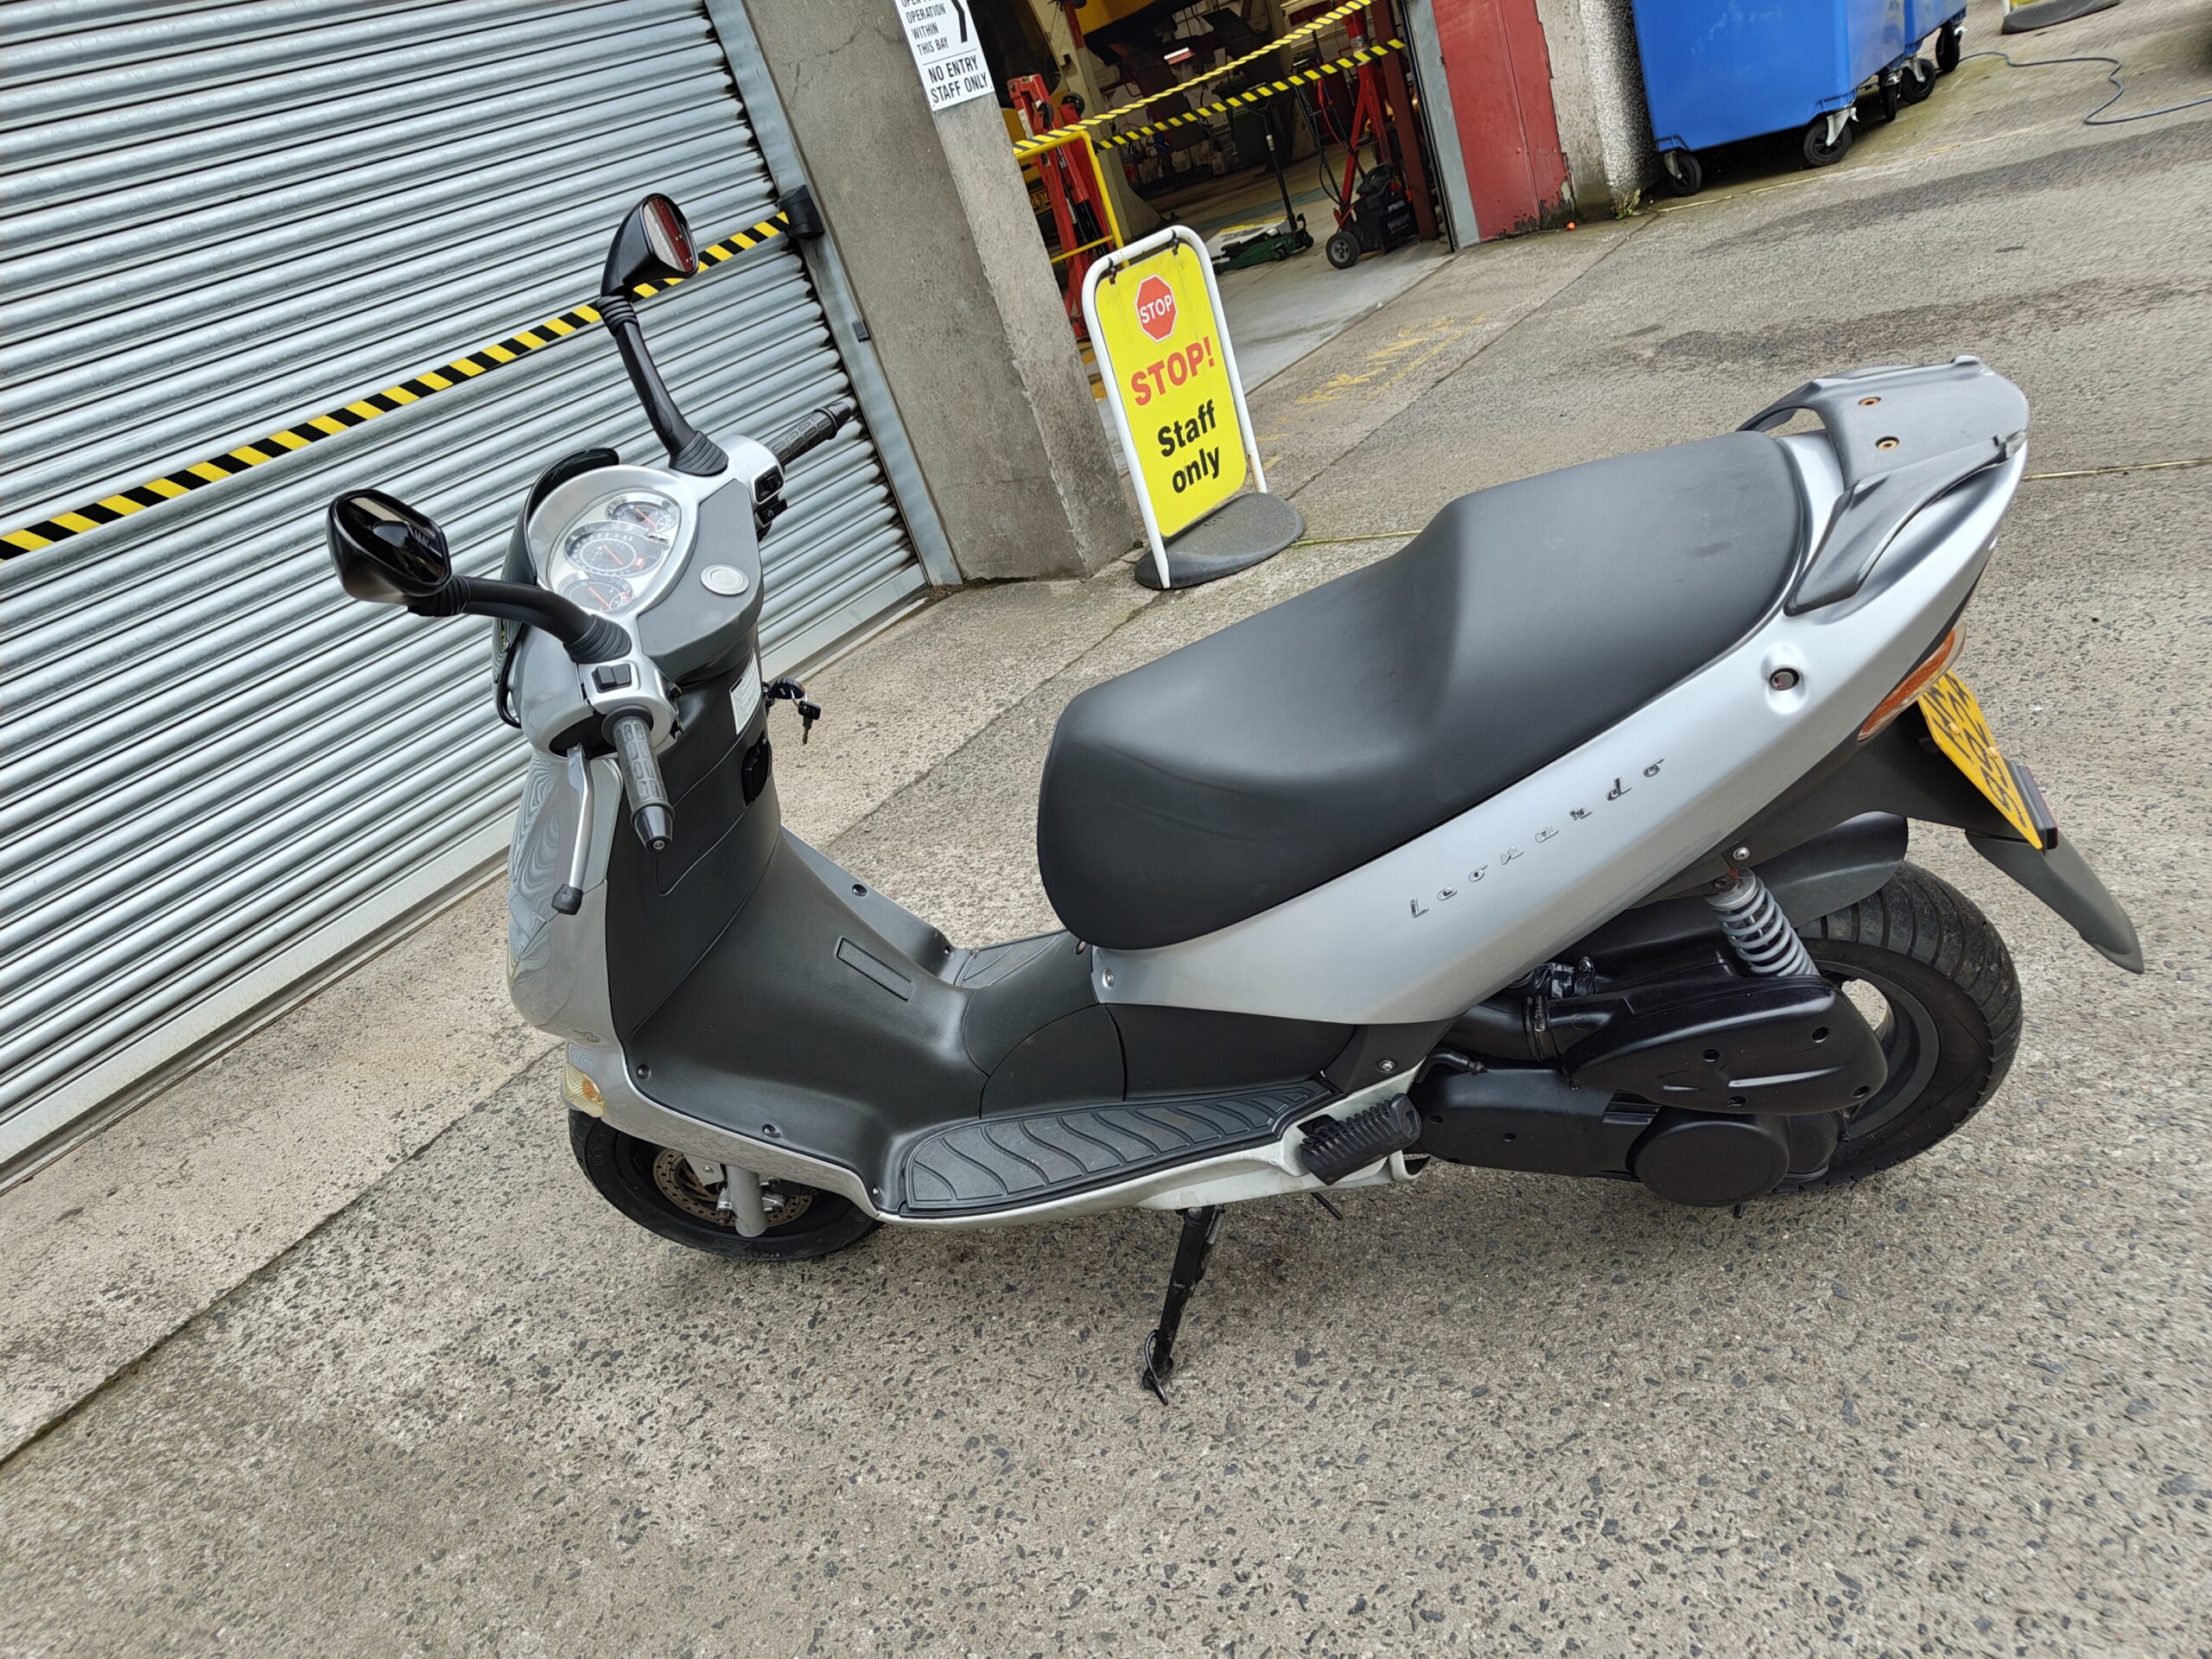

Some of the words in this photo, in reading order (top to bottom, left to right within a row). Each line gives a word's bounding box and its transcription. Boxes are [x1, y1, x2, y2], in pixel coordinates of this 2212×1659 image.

[906, 3, 946, 24] OPERATION
[911, 22, 939, 40] WITHIN
[917, 41, 935, 55] THIS
[935, 36, 949, 51] BAY
[928, 66, 944, 83] NO
[945, 54, 978, 78] ENTRY
[931, 80, 961, 104] STAFF
[964, 72, 988, 92] ONLY
[1139, 292, 1173, 325] STOP
[1131, 336, 1216, 406] STOP!
[1158, 398, 1217, 458] Staff
[1172, 446, 1220, 493] only
